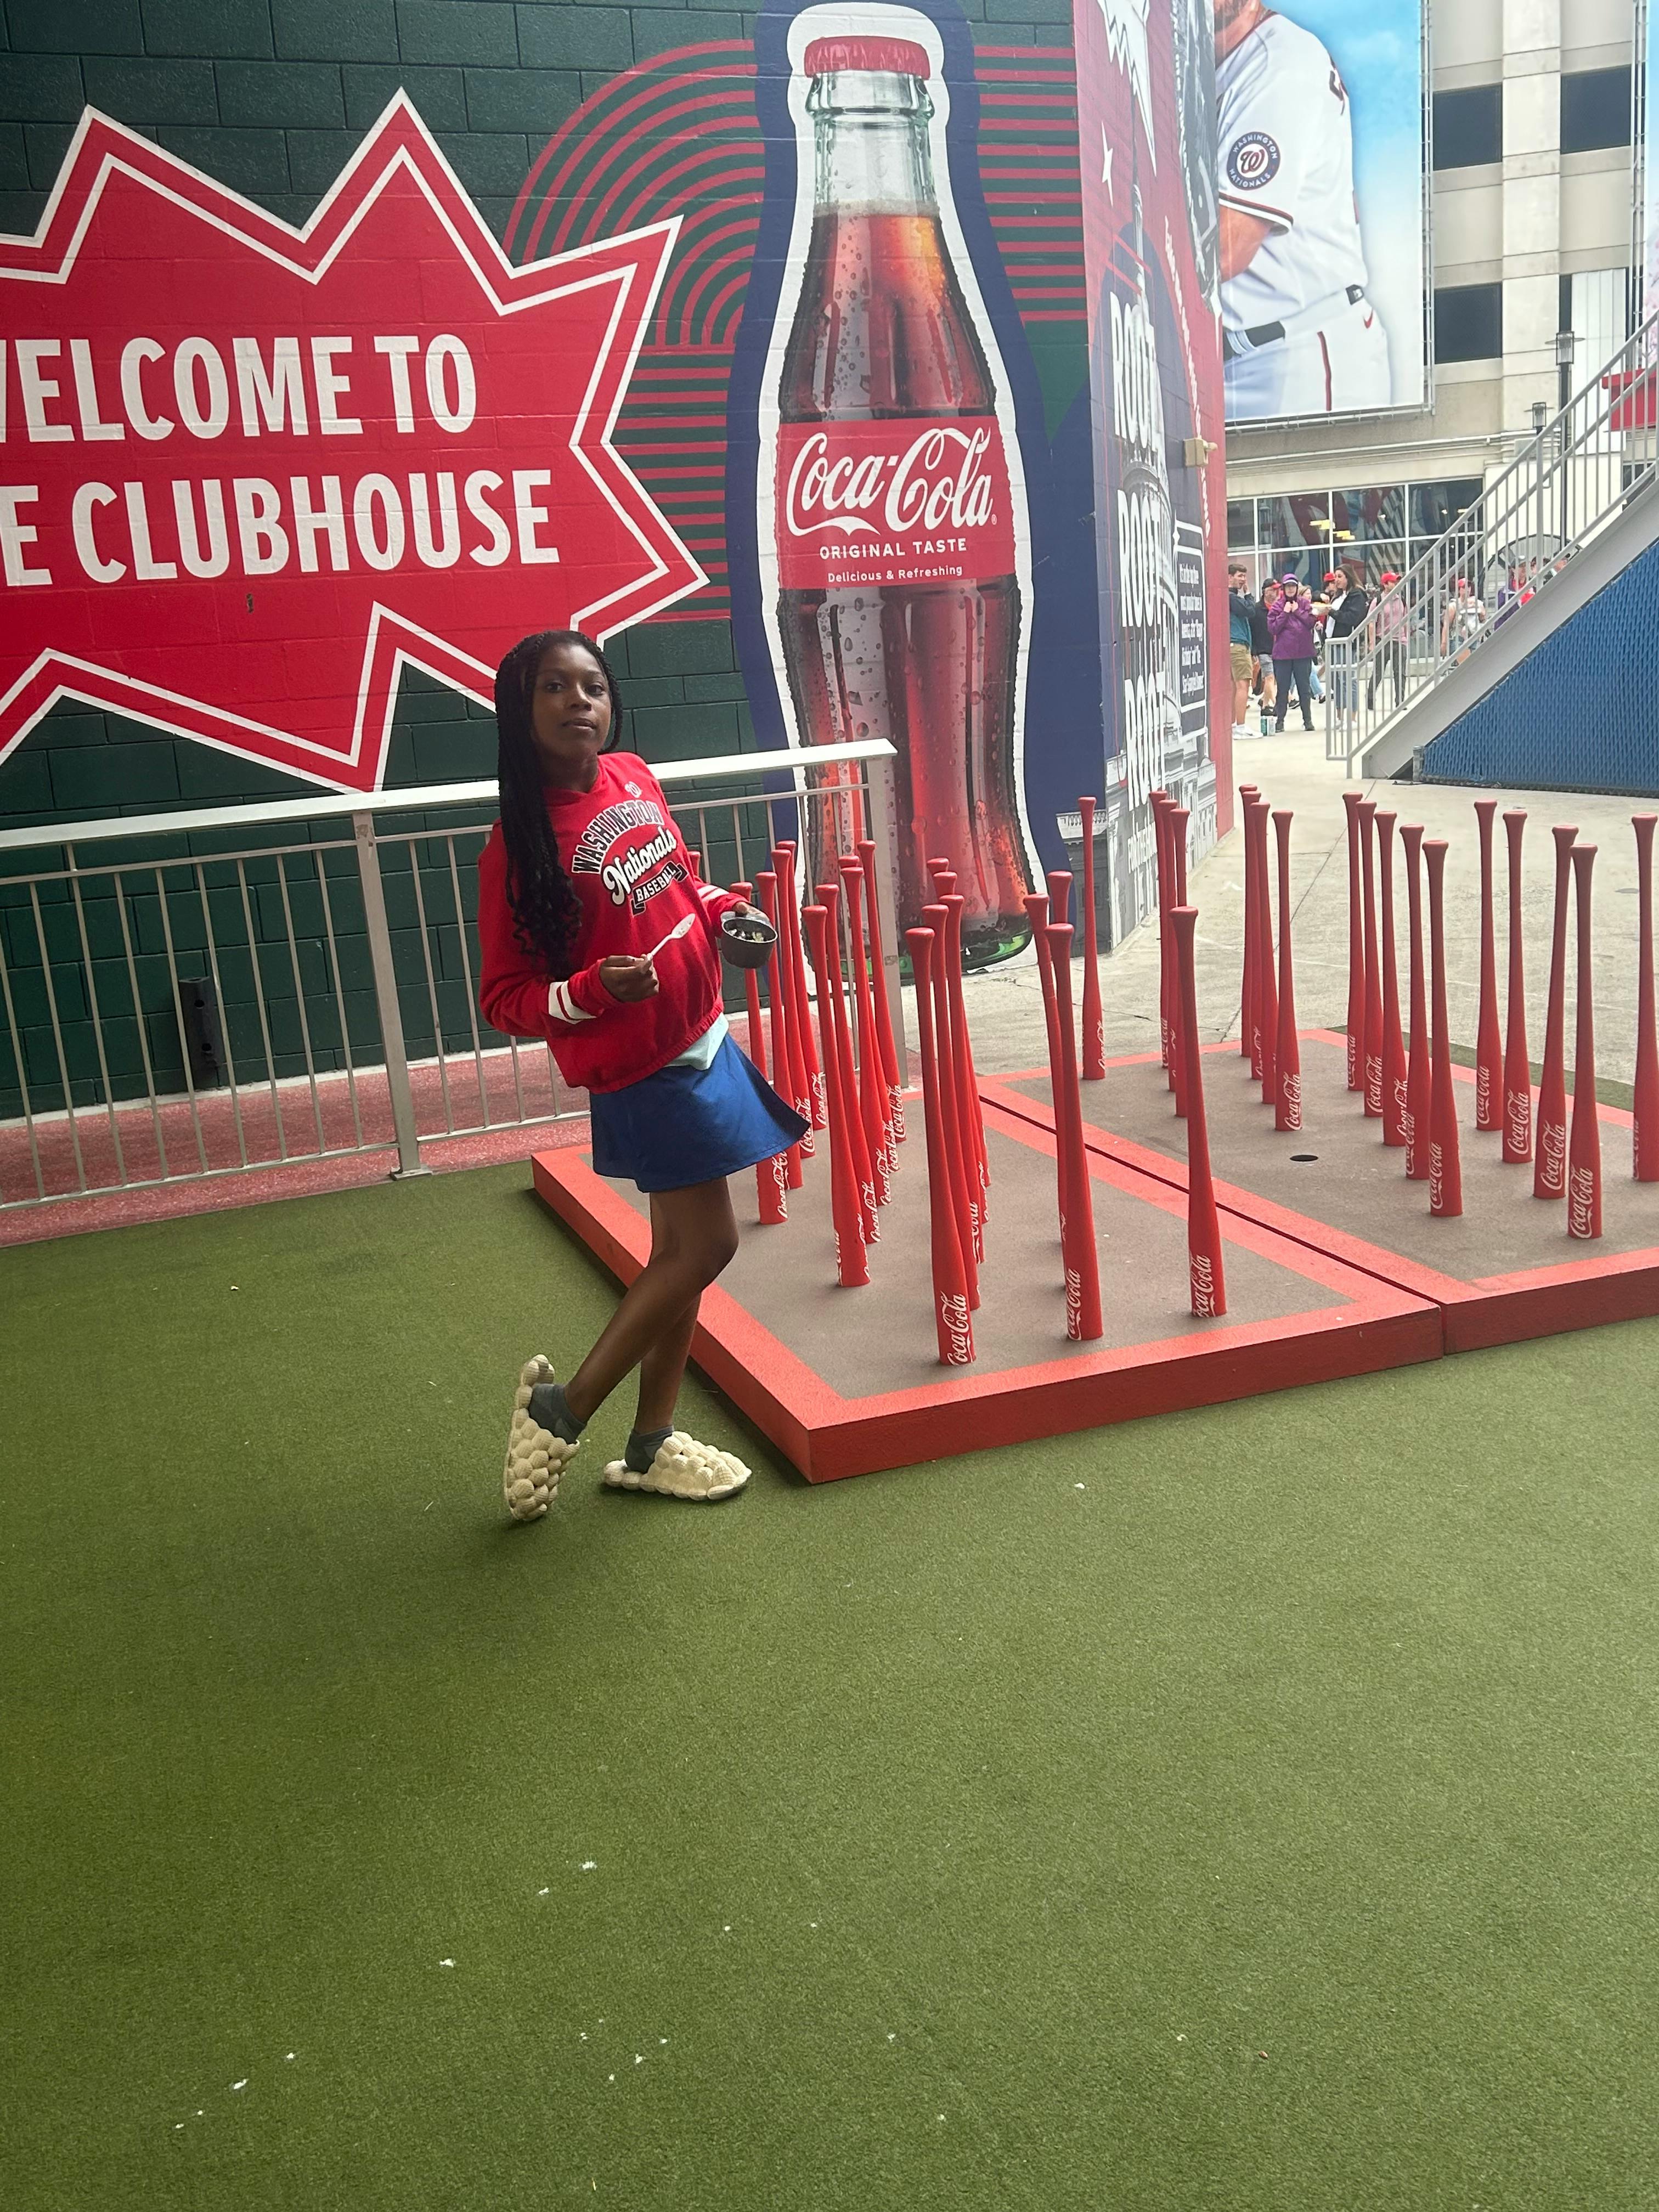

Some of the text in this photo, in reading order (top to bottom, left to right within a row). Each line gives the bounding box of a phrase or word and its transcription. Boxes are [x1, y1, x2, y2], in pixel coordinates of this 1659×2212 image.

[1229, 168, 1271, 188] NATIONALS
[1233, 134, 1278, 160] WASHINGTON
[0, 333, 477, 443] ELCOME TO
[1110, 291, 1156, 452] ROOT
[786, 427, 994, 537] Coca-Cola
[71, 469, 561, 584] CLUBHOUSE
[819, 538, 968, 560] ORIGINAL TASTE
[1117, 489, 1161, 628] ROOT
[827, 565, 963, 583] Delicious & Refreshing
[1125, 671, 1166, 811] ROOT
[571, 799, 665, 874] WASHINGTON
[603, 826, 678, 905] Nationals
[636, 865, 677, 902] BASEBALL
[1283, 1071, 1302, 1131] Coca-Cola
[1506, 1088, 1529, 1155] Coca-Cola
[1541, 1119, 1565, 1190] Coca-Cola
[1570, 1161, 1594, 1239] Coca-Cola
[940, 1290, 973, 1365] Coca-Cola
